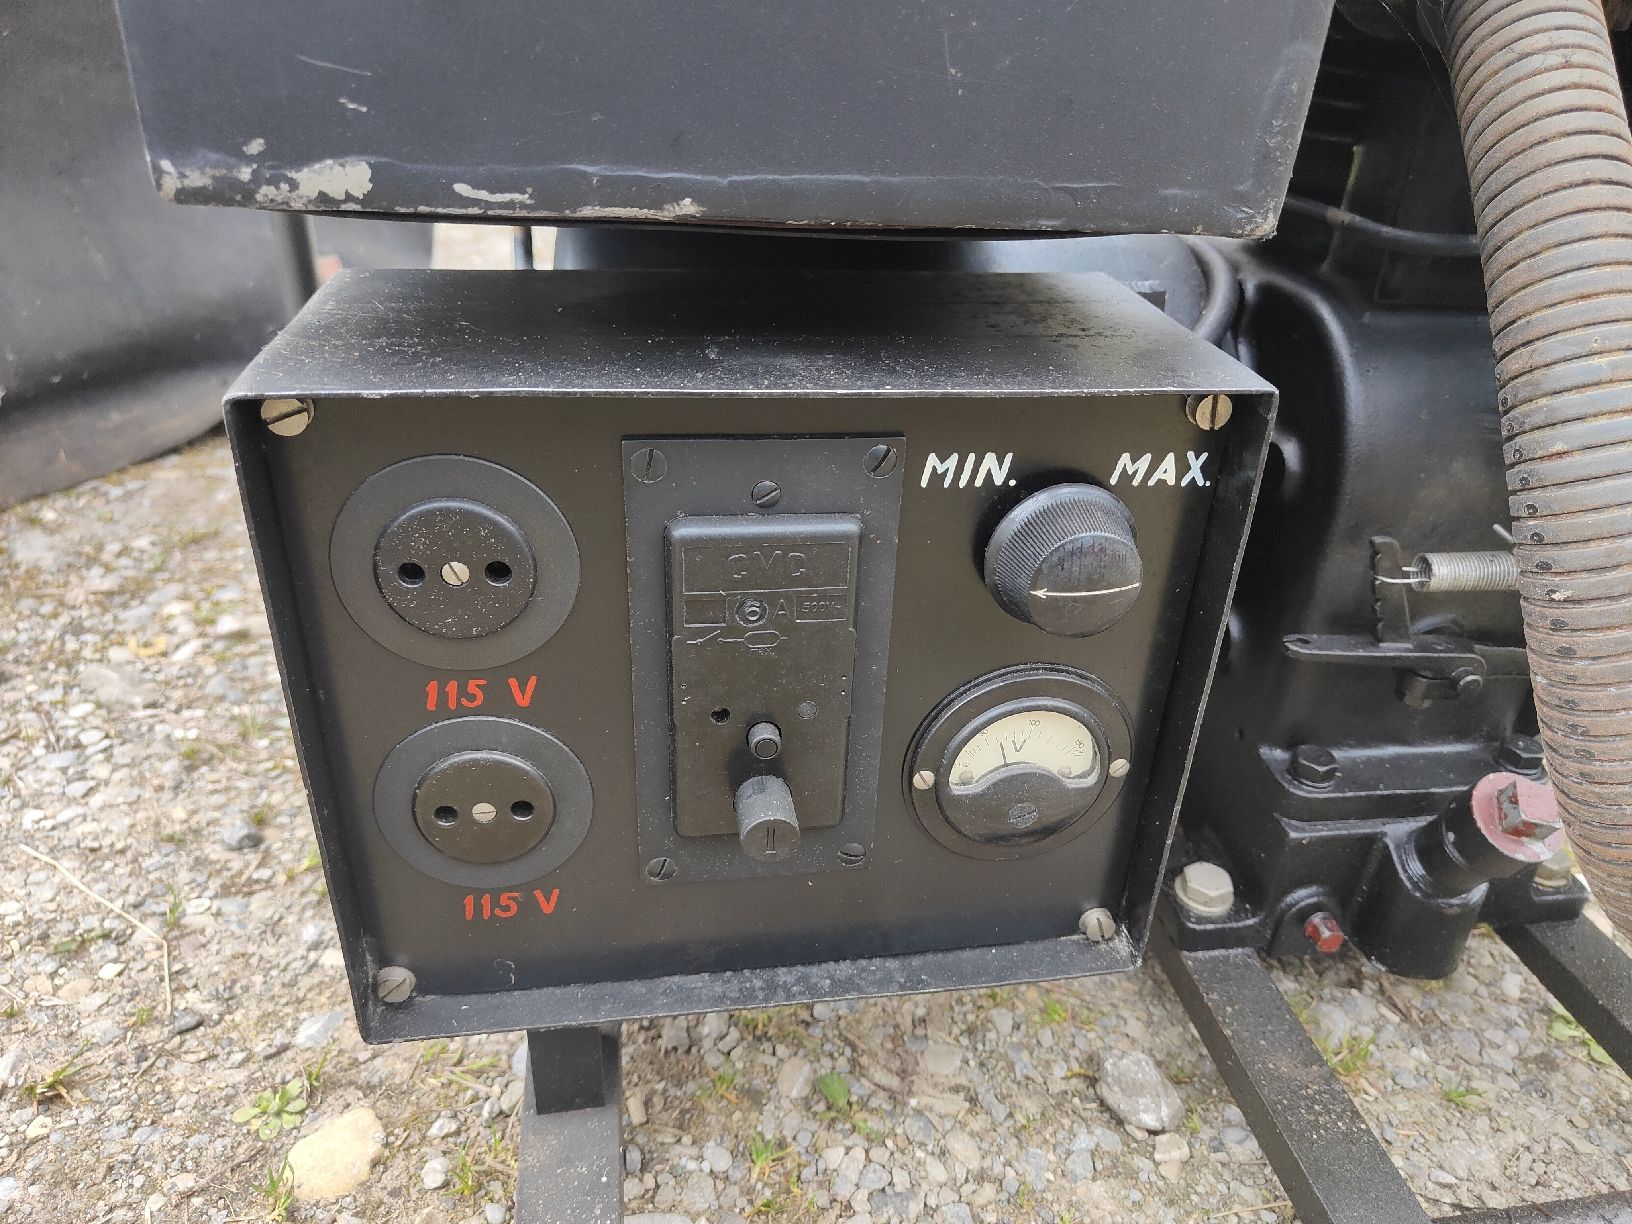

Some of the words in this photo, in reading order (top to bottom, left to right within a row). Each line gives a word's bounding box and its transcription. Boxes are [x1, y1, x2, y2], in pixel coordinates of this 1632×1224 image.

[921, 452, 1016, 488] MIN.
[1110, 451, 1210, 486] MAX.
[772, 599, 791, 620] A
[426, 679, 487, 711] 115
[508, 676, 537, 707] V
[464, 893, 519, 920] 115
[534, 889, 559, 913] V
